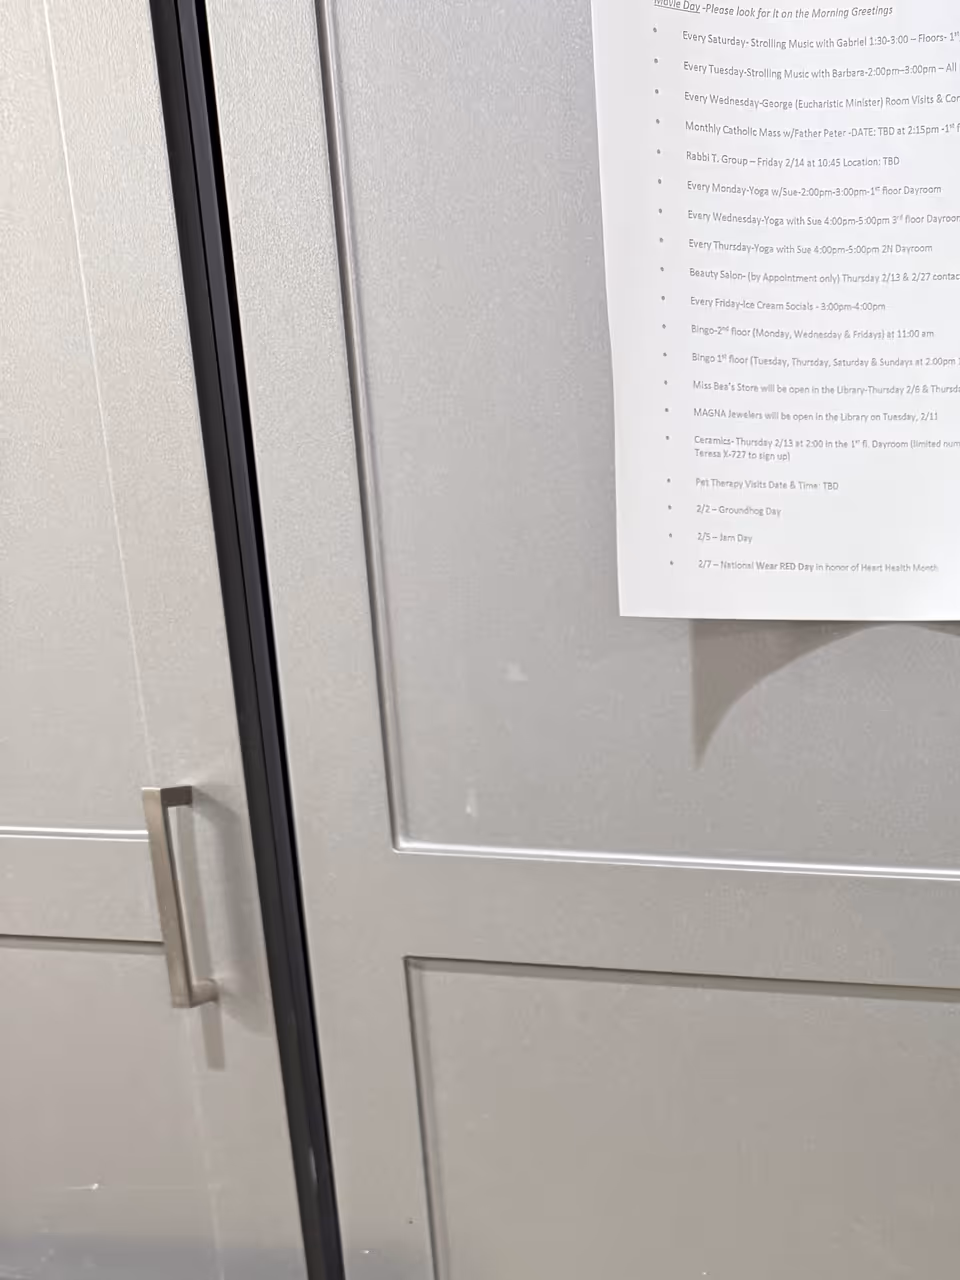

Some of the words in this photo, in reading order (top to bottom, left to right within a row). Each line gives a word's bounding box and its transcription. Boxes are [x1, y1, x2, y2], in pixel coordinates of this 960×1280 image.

[683, 0, 701, 13] Day
[702, 4, 734, 15] -Please
[736, 6, 756, 17] look
[756, 8, 771, 20] for
[795, 8, 810, 19] the
[811, 8, 849, 19] Morning
[851, 6, 893, 17] Greetings
[683, 31, 707, 44] Every
[708, 34, 749, 48] Saturday-
[751, 38, 787, 50] Strolling
[789, 39, 814, 48] Music
[815, 38, 835, 48] with
[836, 37, 867, 47] Gabriel
[870, 35, 909, 46] 1:30-3:00
[918, 34, 947, 43] Floors-
[684, 61, 707, 74] Every
[784, 69, 809, 79] Music
[811, 69, 831, 78] with
[946, 62, 957, 72] All
[684, 92, 708, 104] Every
[845, 98, 884, 108] Minister)
[885, 97, 910, 106] Room
[911, 95, 934, 104] Visits
[685, 121, 721, 135] Monthly
[722, 126, 757, 136] Catholic
[759, 128, 782, 138] Mass
[783, 128, 822, 138] w/Father
[823, 129, 847, 138] Peter
[848, 128, 876, 137] -DATE:
[877, 127, 895, 136] TBD
[897, 127, 906, 135] at
[908, 125, 939, 135] 2:15pm
[686, 151, 710, 162] Rabbi
[721, 155, 748, 166] Group
[757, 157, 783, 168] Friday
[785, 158, 805, 168] 2/14
[818, 158, 841, 168] 10:45
[843, 158, 881, 167] Location:
[882, 156, 900, 166] TBD
[687, 180, 711, 193] Every
[712, 184, 769, 197] Monday-Yoga
[882, 186, 902, 195] floor
[904, 186, 942, 195] Dayroom
[688, 210, 711, 222] Every
[786, 217, 805, 225] with
[807, 217, 822, 226] Sue
[905, 215, 925, 224] floor
[689, 239, 712, 250] Every
[776, 245, 795, 254] with
[797, 245, 812, 254] Sue
[895, 244, 933, 254] Dayroom
[689, 268, 719, 280] Beauty
[720, 270, 746, 280] Salon-
[747, 272, 761, 283] (by
[762, 273, 817, 283] Appointment
[819, 274, 840, 284] only)
[842, 274, 880, 283] Thursday
[882, 273, 901, 283] 2/13
[911, 272, 931, 282] 2/27
[690, 296, 714, 307] Every
[715, 298, 755, 310] Friday-Ice
[757, 301, 784, 310] Cream
[785, 302, 814, 311] Socials
[731, 327, 751, 336] floor
[752, 328, 792, 339] (Monday,
[793, 330, 842, 339] Wednesday
[853, 330, 885, 340] Fridays)
[897, 329, 920, 338] 11:00
